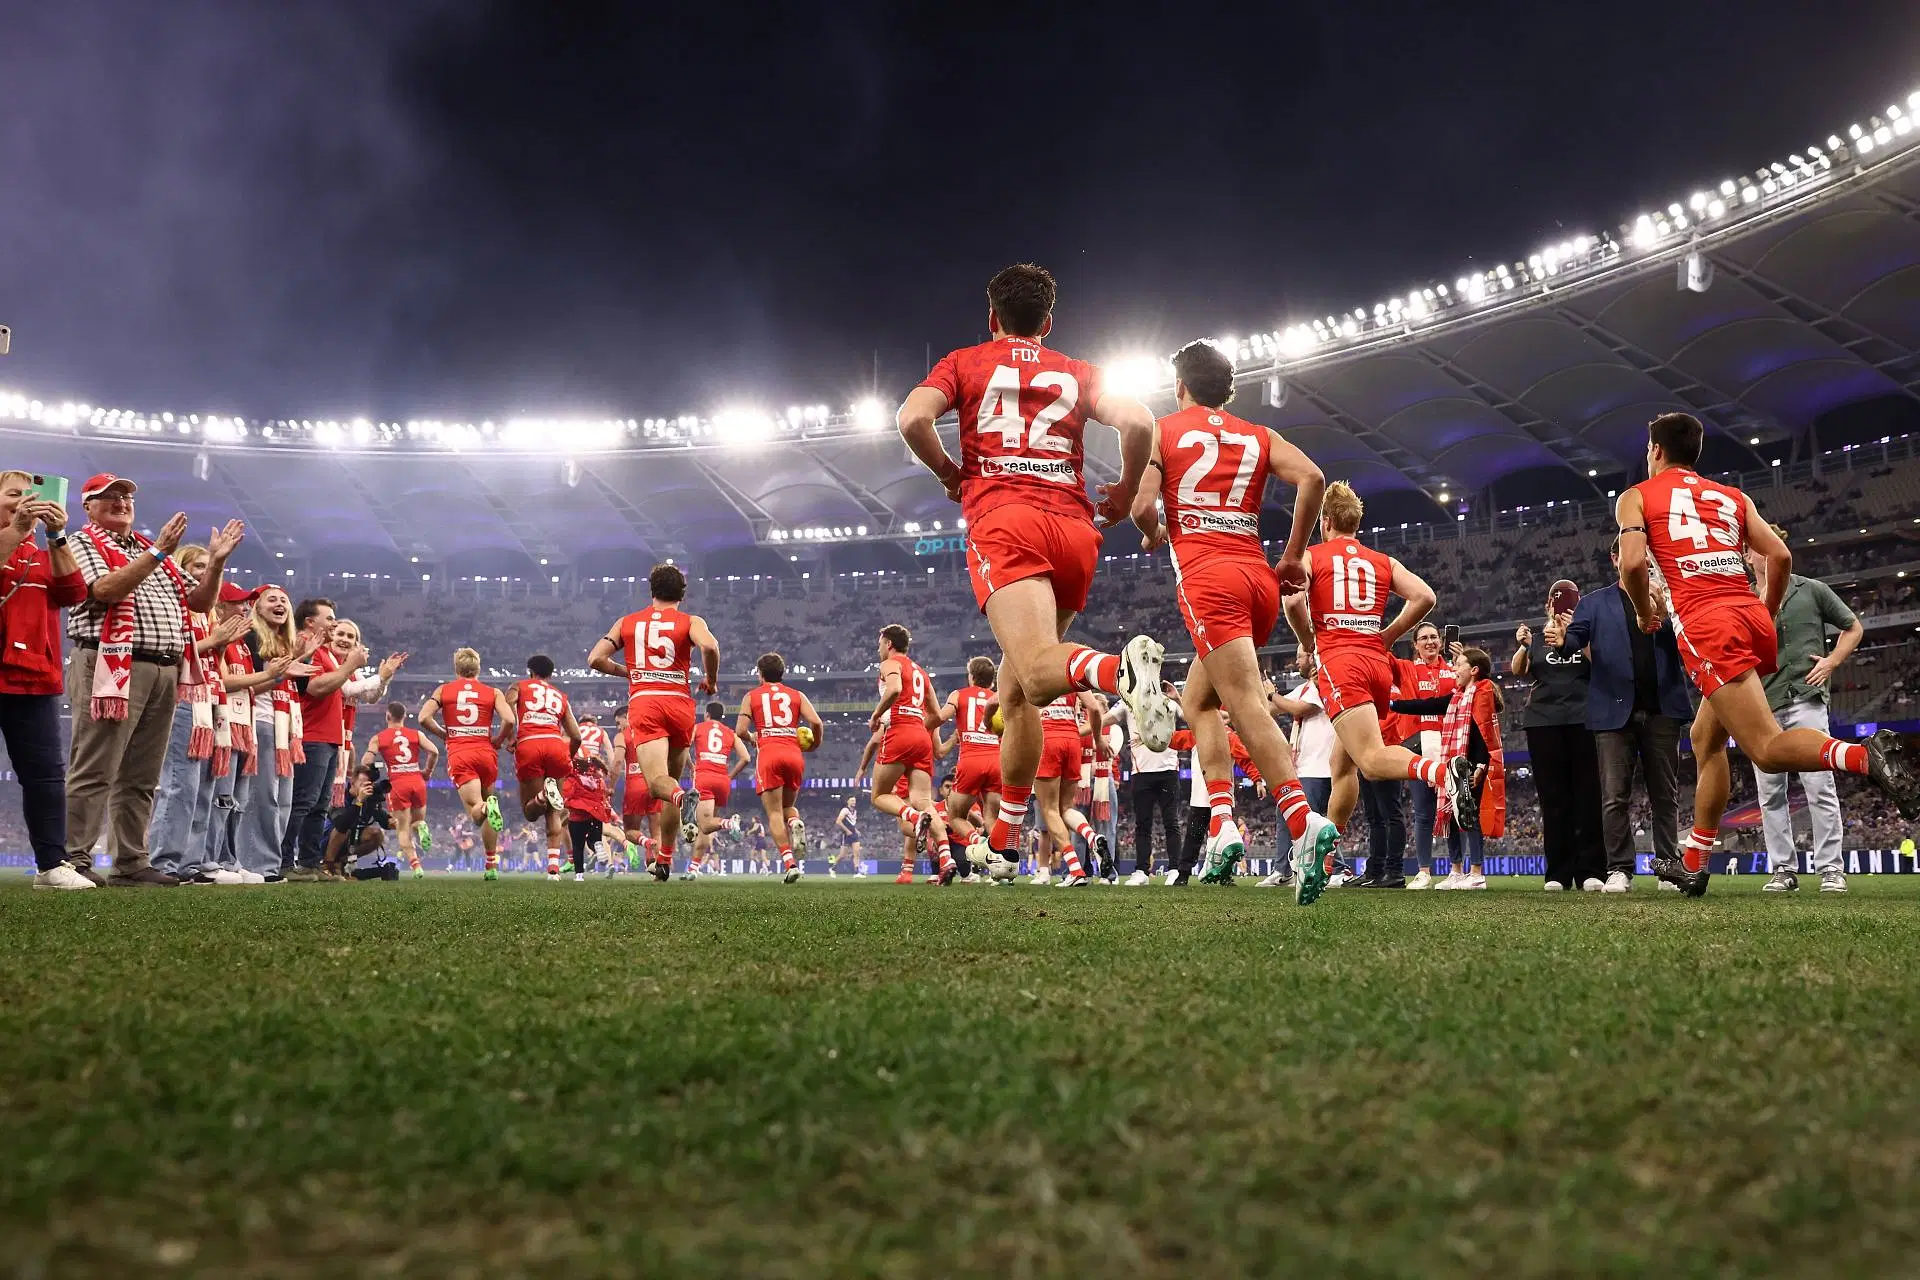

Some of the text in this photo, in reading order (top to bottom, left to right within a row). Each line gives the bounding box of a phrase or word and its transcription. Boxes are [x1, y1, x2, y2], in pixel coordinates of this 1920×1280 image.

[1011, 348, 1040, 363] FOX
[977, 365, 1079, 454] 42
[1004, 461, 1073, 474] realestate
[1177, 430, 1260, 507] 27
[1668, 488, 1740, 550] 43
[1333, 555, 1376, 611] 10
[635, 621, 675, 669] 15
[525, 683, 562, 715] 36
[912, 669, 925, 707] 9
[456, 690, 479, 725] 5
[761, 692, 793, 726] 13
[393, 736, 412, 763] 3
[708, 728, 723, 753] 6
